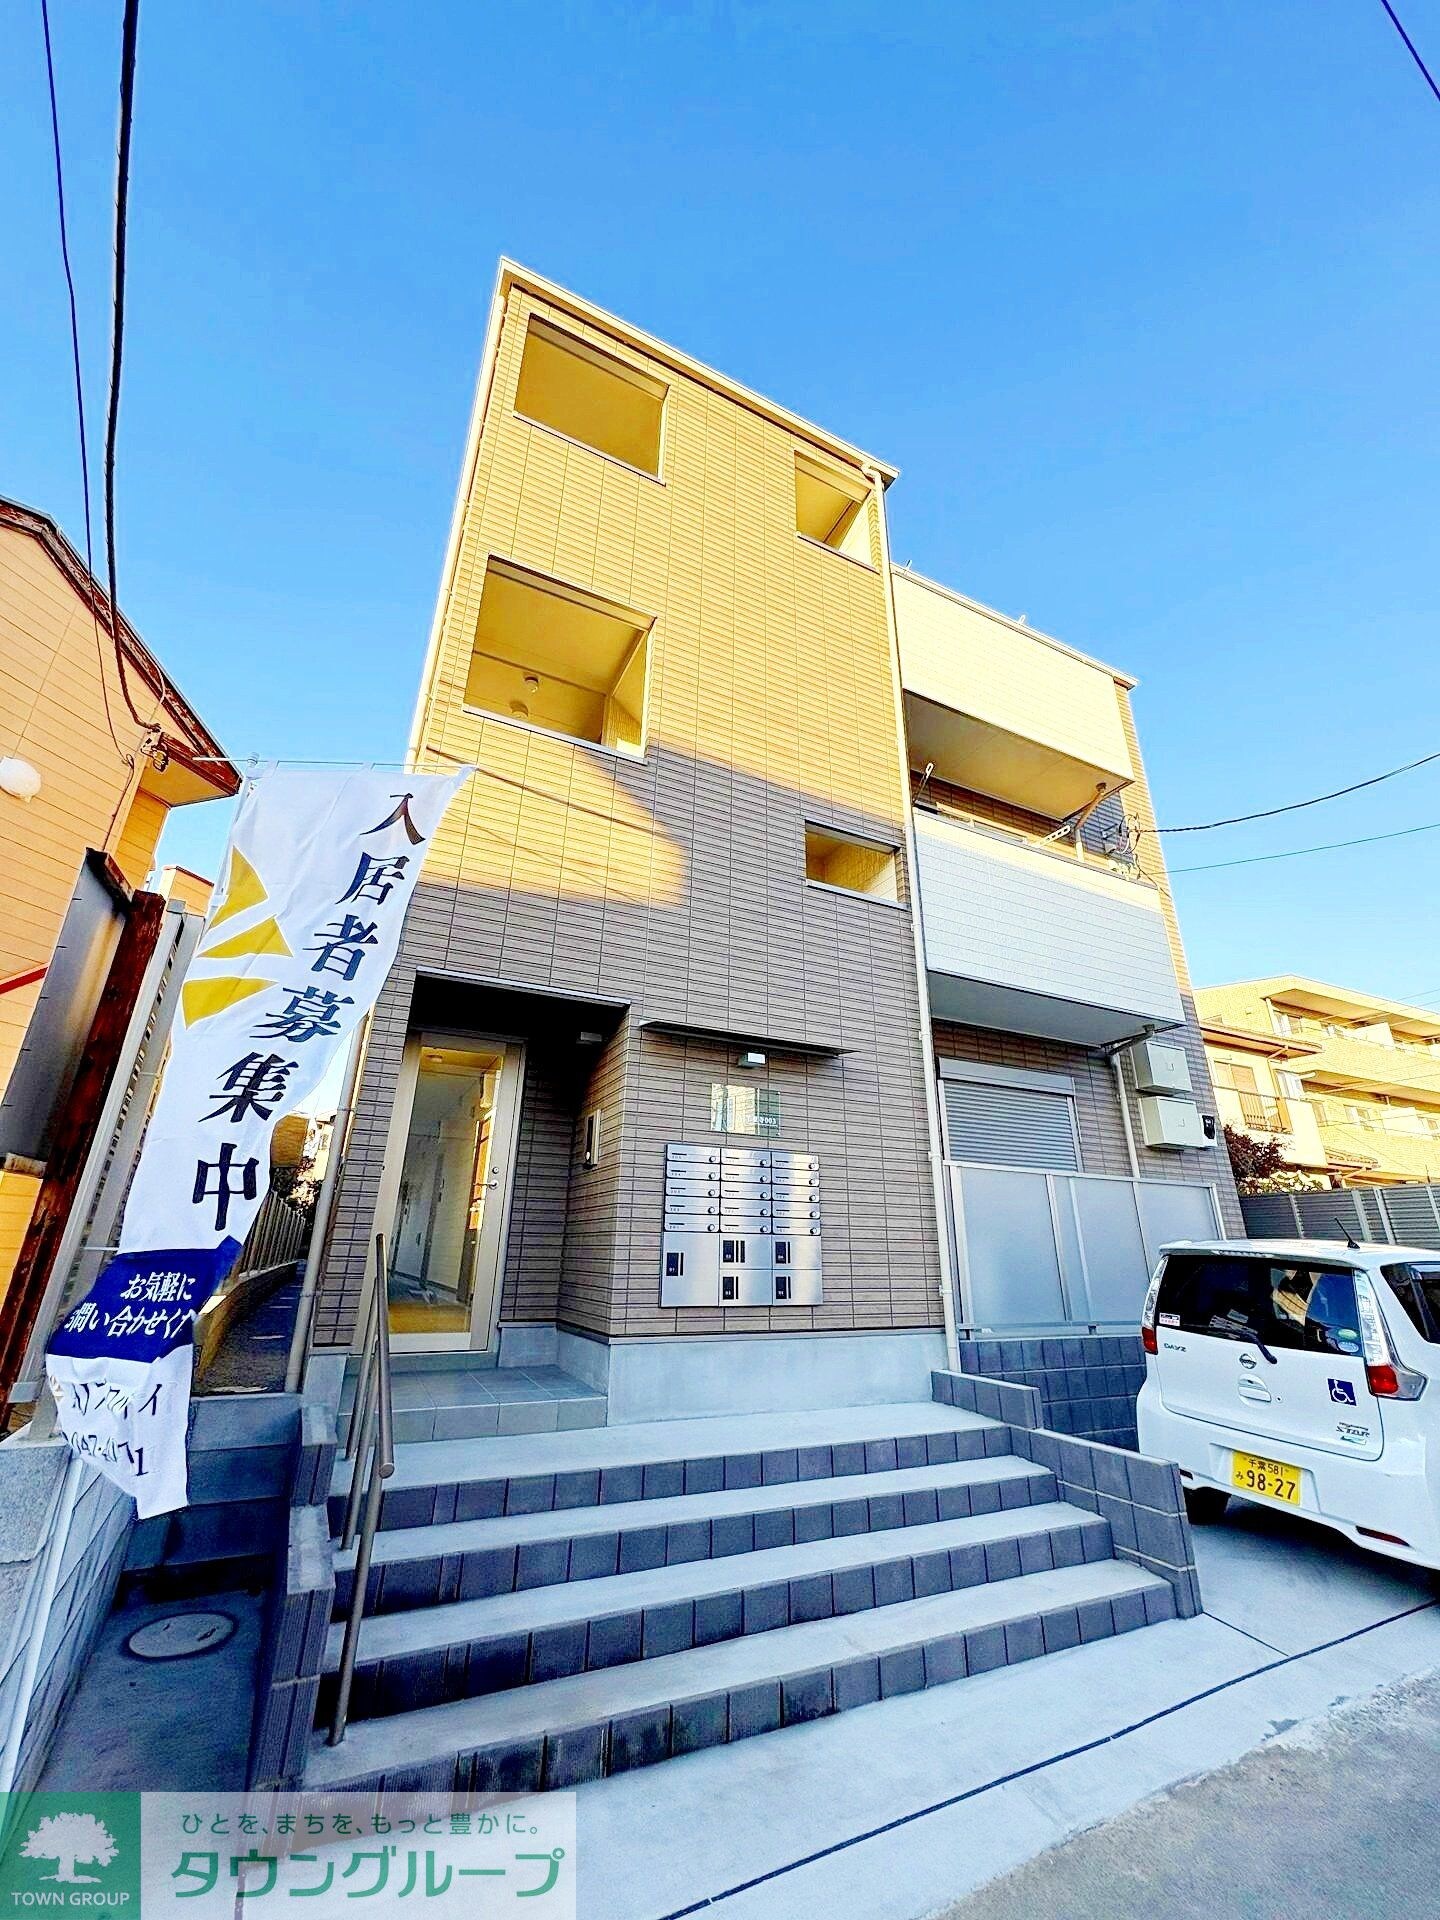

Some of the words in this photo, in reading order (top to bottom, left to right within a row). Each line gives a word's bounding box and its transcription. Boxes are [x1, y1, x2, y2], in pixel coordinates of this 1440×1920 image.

[192, 793, 426, 1231] 入居者募集中
[120, 1271, 197, 1302] お気軽に
[1246, 1469, 1296, 1500] 98-27
